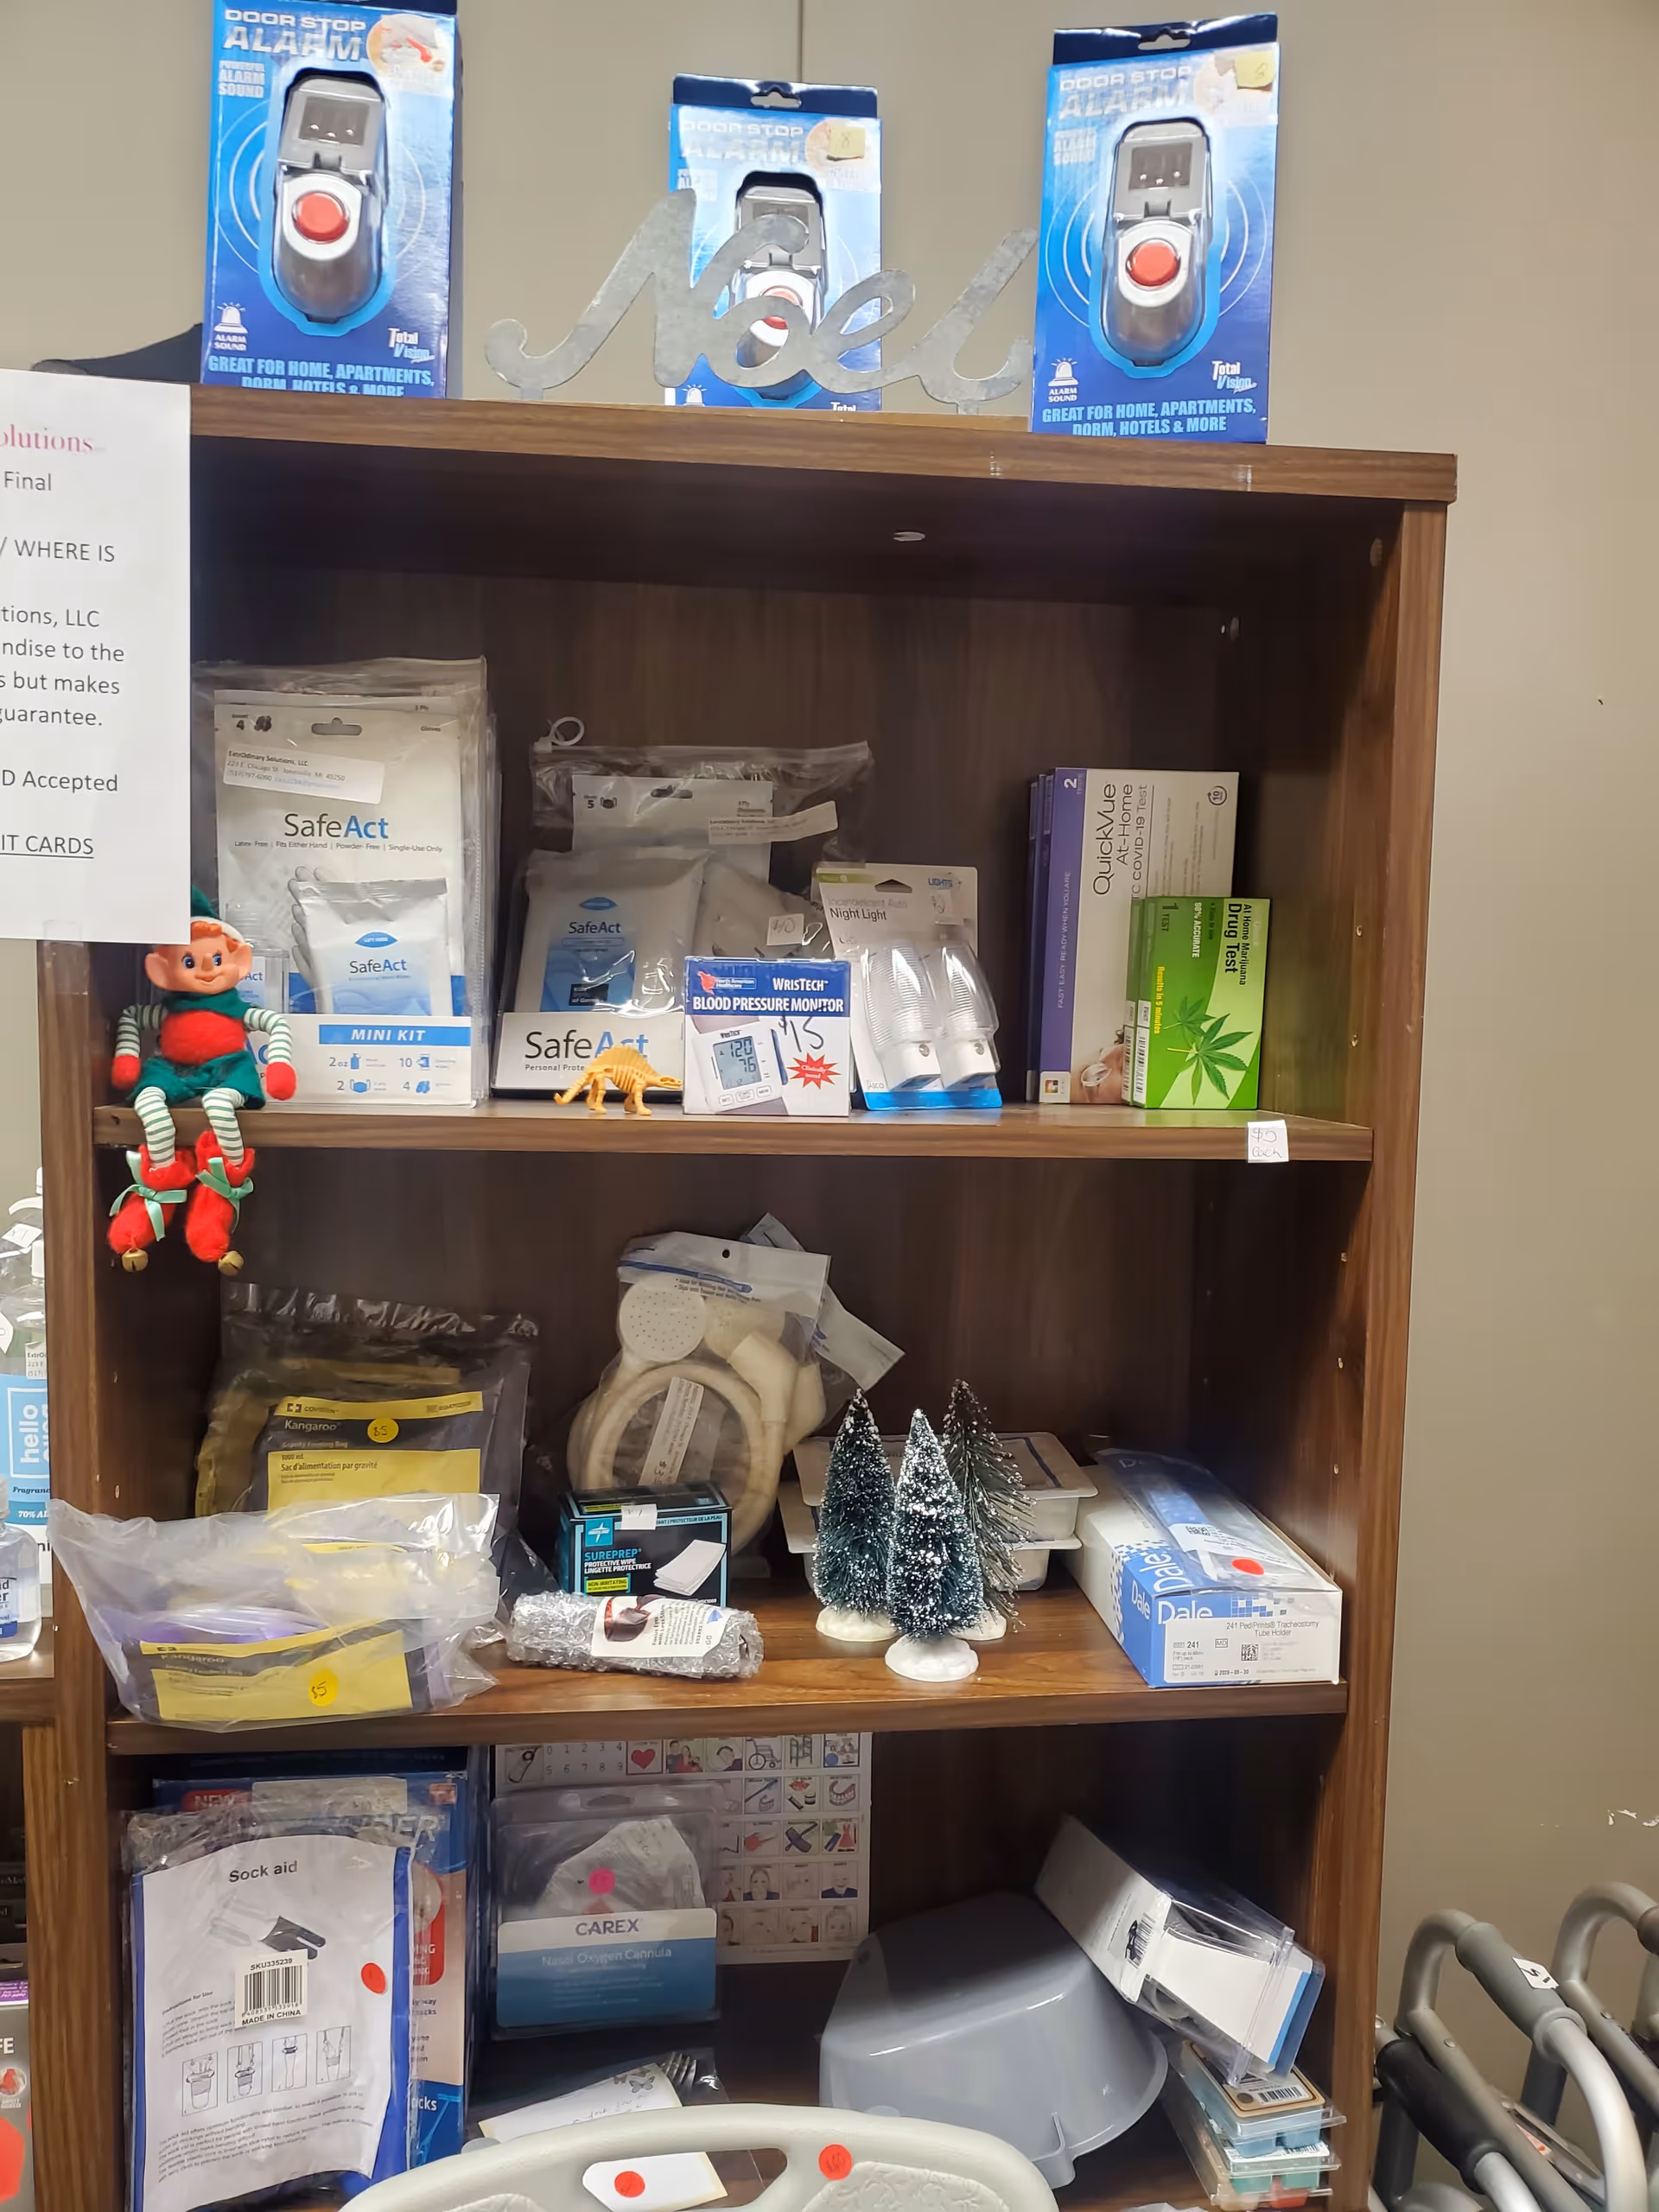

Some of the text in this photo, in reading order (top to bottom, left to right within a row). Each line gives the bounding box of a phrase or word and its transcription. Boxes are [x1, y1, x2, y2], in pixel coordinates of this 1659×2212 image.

[225, 9, 366, 32] DOOR STOP
[223, 26, 363, 61] ALARM
[219, 69, 265, 85] ALARM
[1059, 66, 1192, 91] DOOR STOP
[218, 83, 264, 98] SOUND
[1058, 85, 1187, 119] ALARM
[747, 123, 804, 137] STOP
[682, 139, 800, 164] ALARM
[484, 188, 1038, 404] Noel
[214, 334, 247, 343] ALARM
[388, 327, 418, 347] Total
[214, 342, 246, 351] SOUND
[393, 343, 432, 361] Vision
[208, 356, 435, 387] GREAT FOR HOME, APARTMENTS,
[1211, 359, 1241, 380] Total
[363, 385, 404, 397] MORE
[1048, 386, 1077, 395] ALARM
[1217, 376, 1252, 391] Vision
[1048, 394, 1077, 403] SOUND
[1042, 398, 1256, 423] GREAT FOR HOME, APARTMENTS,
[1072, 416, 1227, 437] DORM, HOTELS & MORE
[3, 470, 52, 491] Final
[15, 538, 115, 563] WHERE IS
[1, 605, 100, 628] tions, LLC
[2, 639, 125, 663] ndise to the
[13, 671, 120, 694] but makes
[2, 769, 118, 793] D Accepted
[1064, 778, 1077, 789] 2
[284, 812, 390, 839] SafeAct
[1116, 784, 1133, 866] At-Home
[1132, 785, 1148, 881] COVID-19 Test
[1, 834, 94, 855] IT CARDS
[1092, 783, 1116, 895] QuickVue
[426, 844, 443, 854] Only
[830, 908, 887, 922] Night Light
[1162, 902, 1179, 911] 1
[569, 921, 622, 935] SafeAct
[1160, 912, 1170, 932] TEST
[1192, 920, 1202, 958] ACCURATE
[1224, 903, 1243, 974] Drug Test
[1238, 904, 1252, 985] At Home Marijuana
[349, 958, 408, 974] SafeAct
[1155, 966, 1166, 992] Results
[693, 996, 844, 1013] BLOOD PRESSURE MONITOR
[1153, 1007, 1163, 1034] minutes
[351, 1028, 427, 1041] MINI KIT
[729, 1039, 753, 1058] 120
[329, 1057, 336, 1067] 2
[399, 1057, 413, 1068] 10
[524, 1064, 561, 1072] Personal
[739, 1057, 757, 1073] 76
[336, 1080, 345, 1090] 2
[402, 1081, 410, 1091] 4
[18, 1404, 41, 1463] hello
[284, 1420, 337, 1432] Kangaroo
[354, 1461, 378, 1471] gravité
[670, 1516, 697, 1525] PROTECTEUR
[584, 1559, 620, 1567] PROTECTIVE
[584, 1563, 652, 1574] LINGETTE PROTECTRICE
[1131, 1580, 1151, 1620] Dale
[1158, 1600, 1213, 1624] Dale
[1276, 1621, 1320, 1630] Tracheostomy
[564, 1745, 569, 1754] 1
[581, 1743, 588, 1752] 2
[600, 1742, 605, 1751] 3
[617, 1742, 622, 1751] 4
[545, 1765, 552, 1775] 5
[563, 1764, 570, 1773] 6
[228, 1860, 299, 1884] Sock aid
[575, 1918, 639, 1936] CAREX
[250, 1957, 294, 1972] SKU335239
[576, 1952, 624, 1965] Oxygen
[625, 1948, 672, 1960] Cannula
[241, 2015, 264, 2026] MADE
[276, 2009, 302, 2018] CHINA
